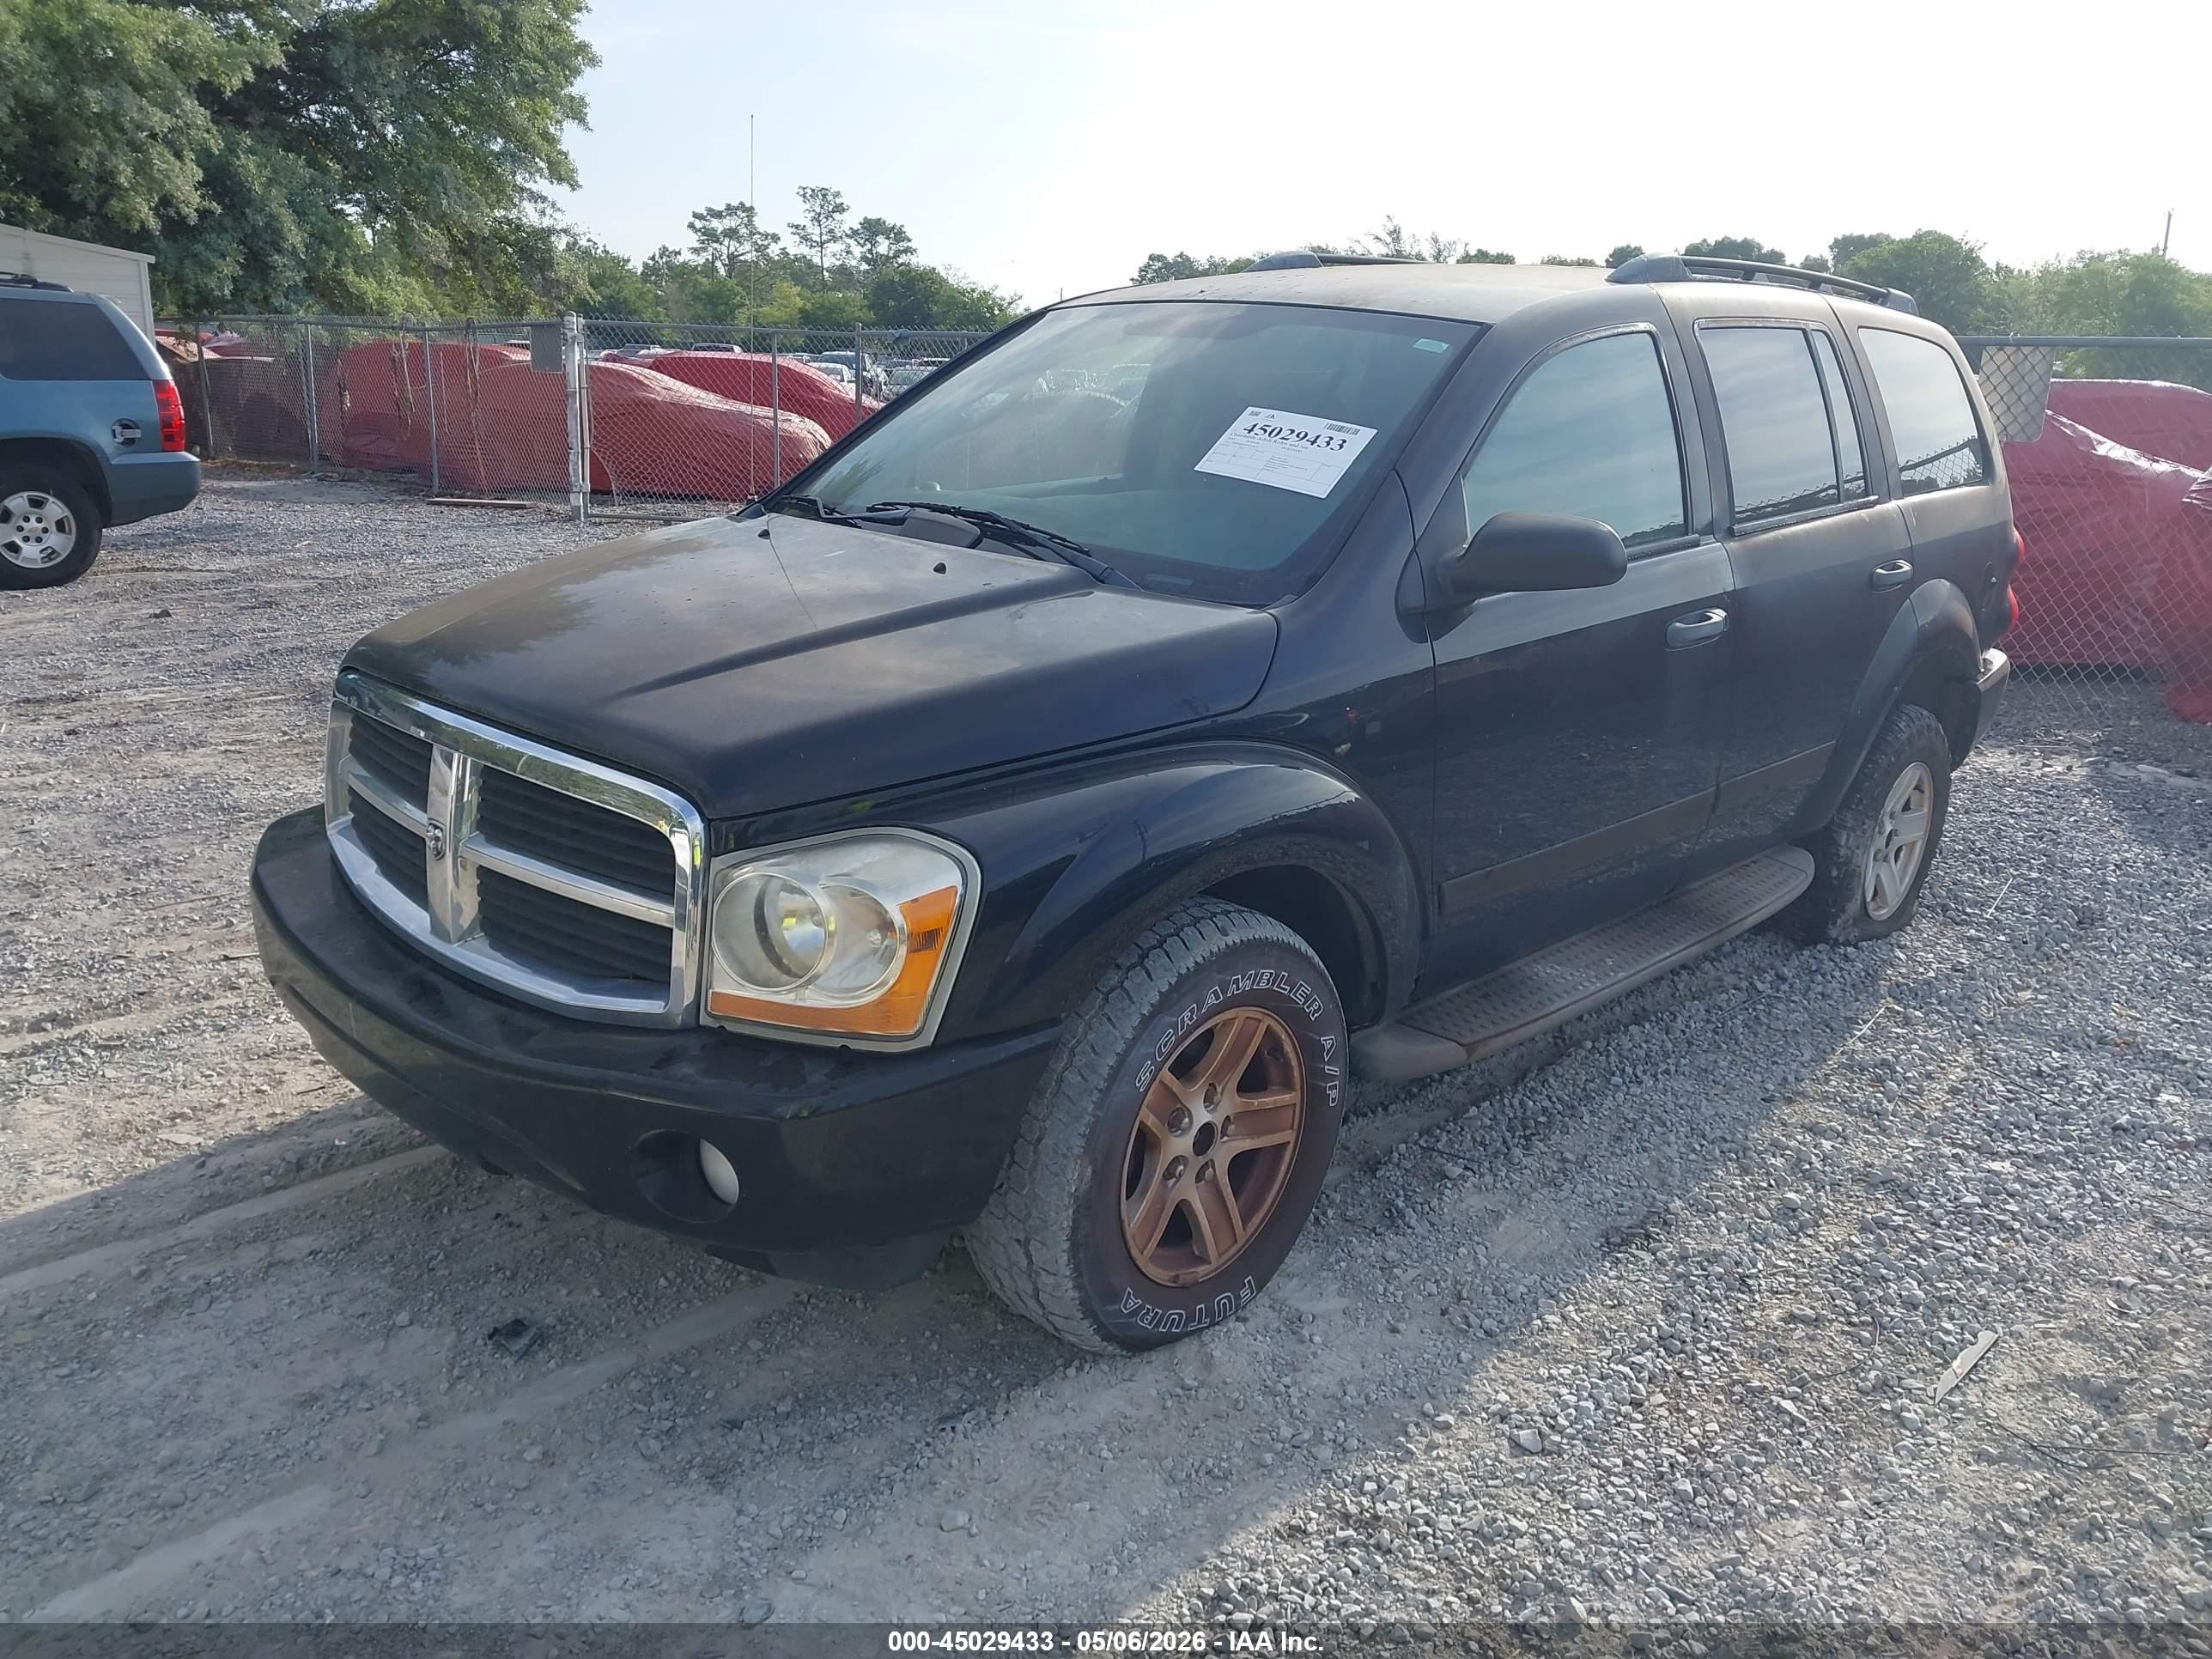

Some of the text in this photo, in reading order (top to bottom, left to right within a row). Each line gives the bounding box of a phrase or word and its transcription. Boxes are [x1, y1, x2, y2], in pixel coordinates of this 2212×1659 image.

[1243, 422, 1347, 452] 45029433
[1135, 969, 1324, 1092] SCRAMBLER
[1119, 1275, 1257, 1332] FUTURA
